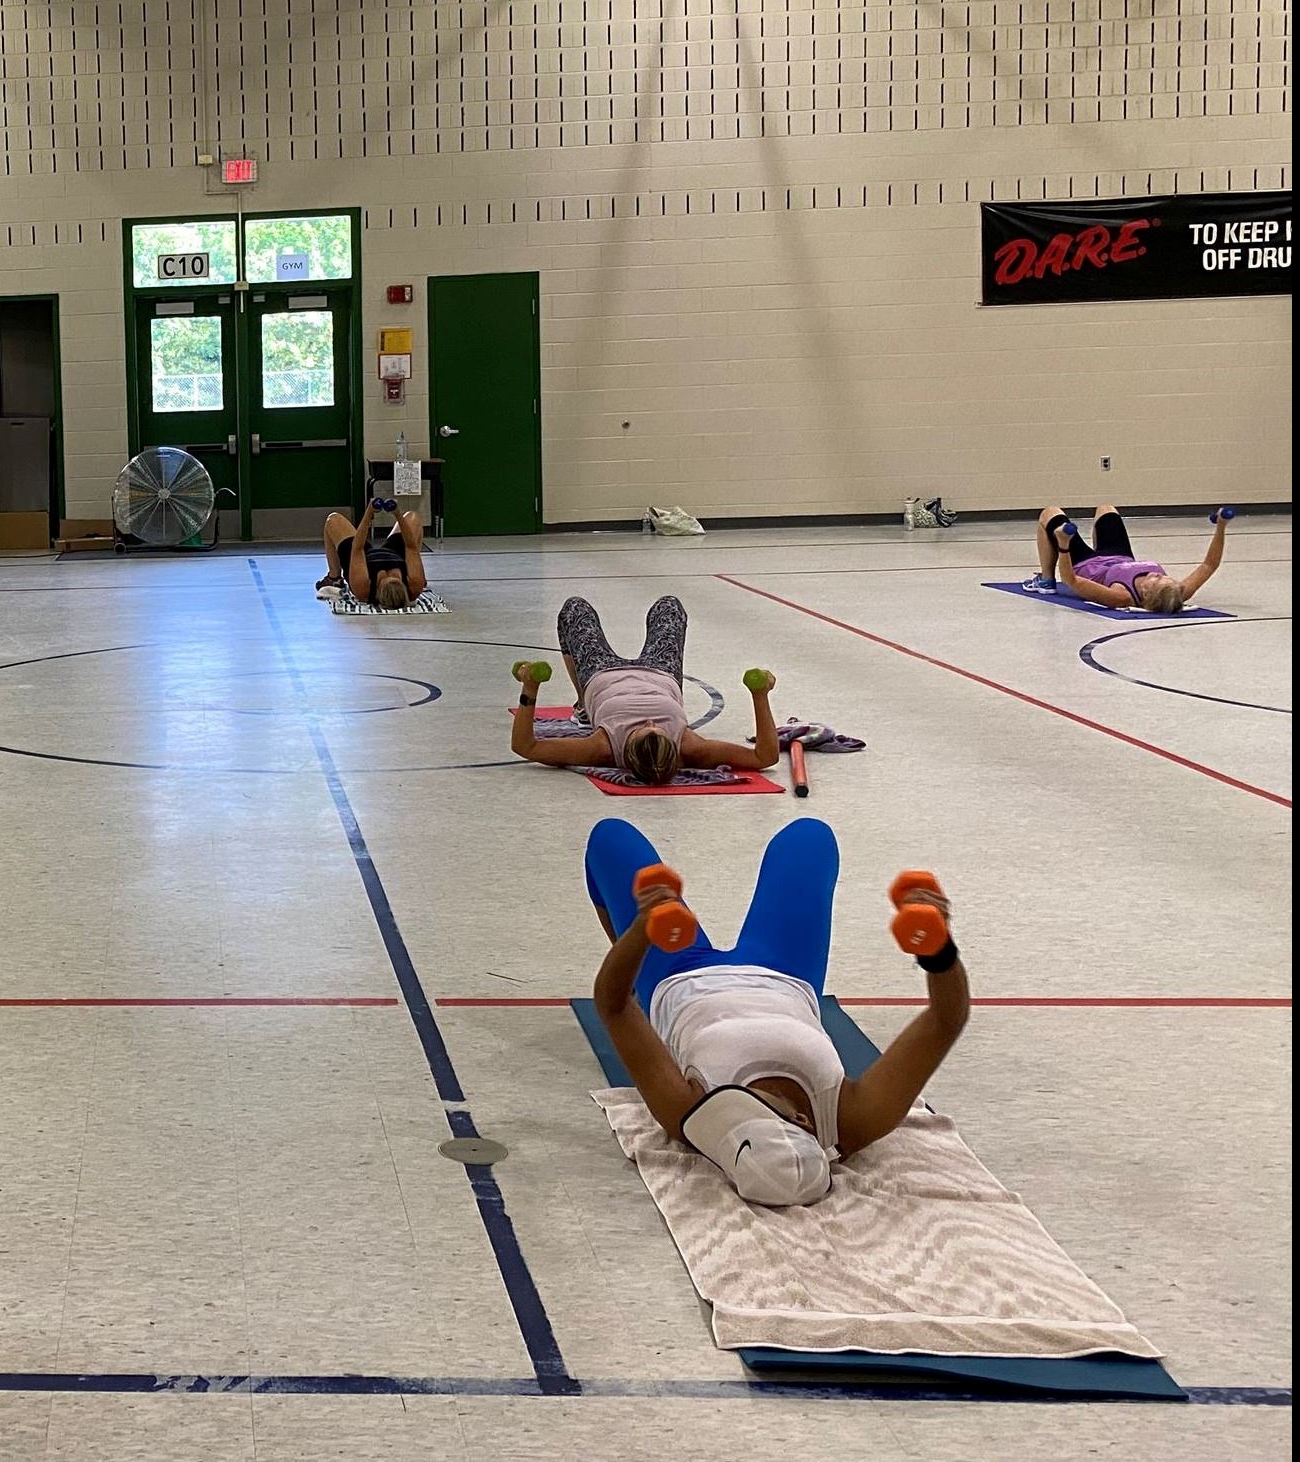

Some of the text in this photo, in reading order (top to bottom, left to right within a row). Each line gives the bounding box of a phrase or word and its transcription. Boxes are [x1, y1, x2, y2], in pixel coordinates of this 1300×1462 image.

[1189, 223, 1218, 245] TO
[1224, 221, 1279, 244] KEEP
[163, 256, 204, 276] C10
[282, 262, 303, 271] GYM
[1202, 246, 1292, 271] OFF DRU
